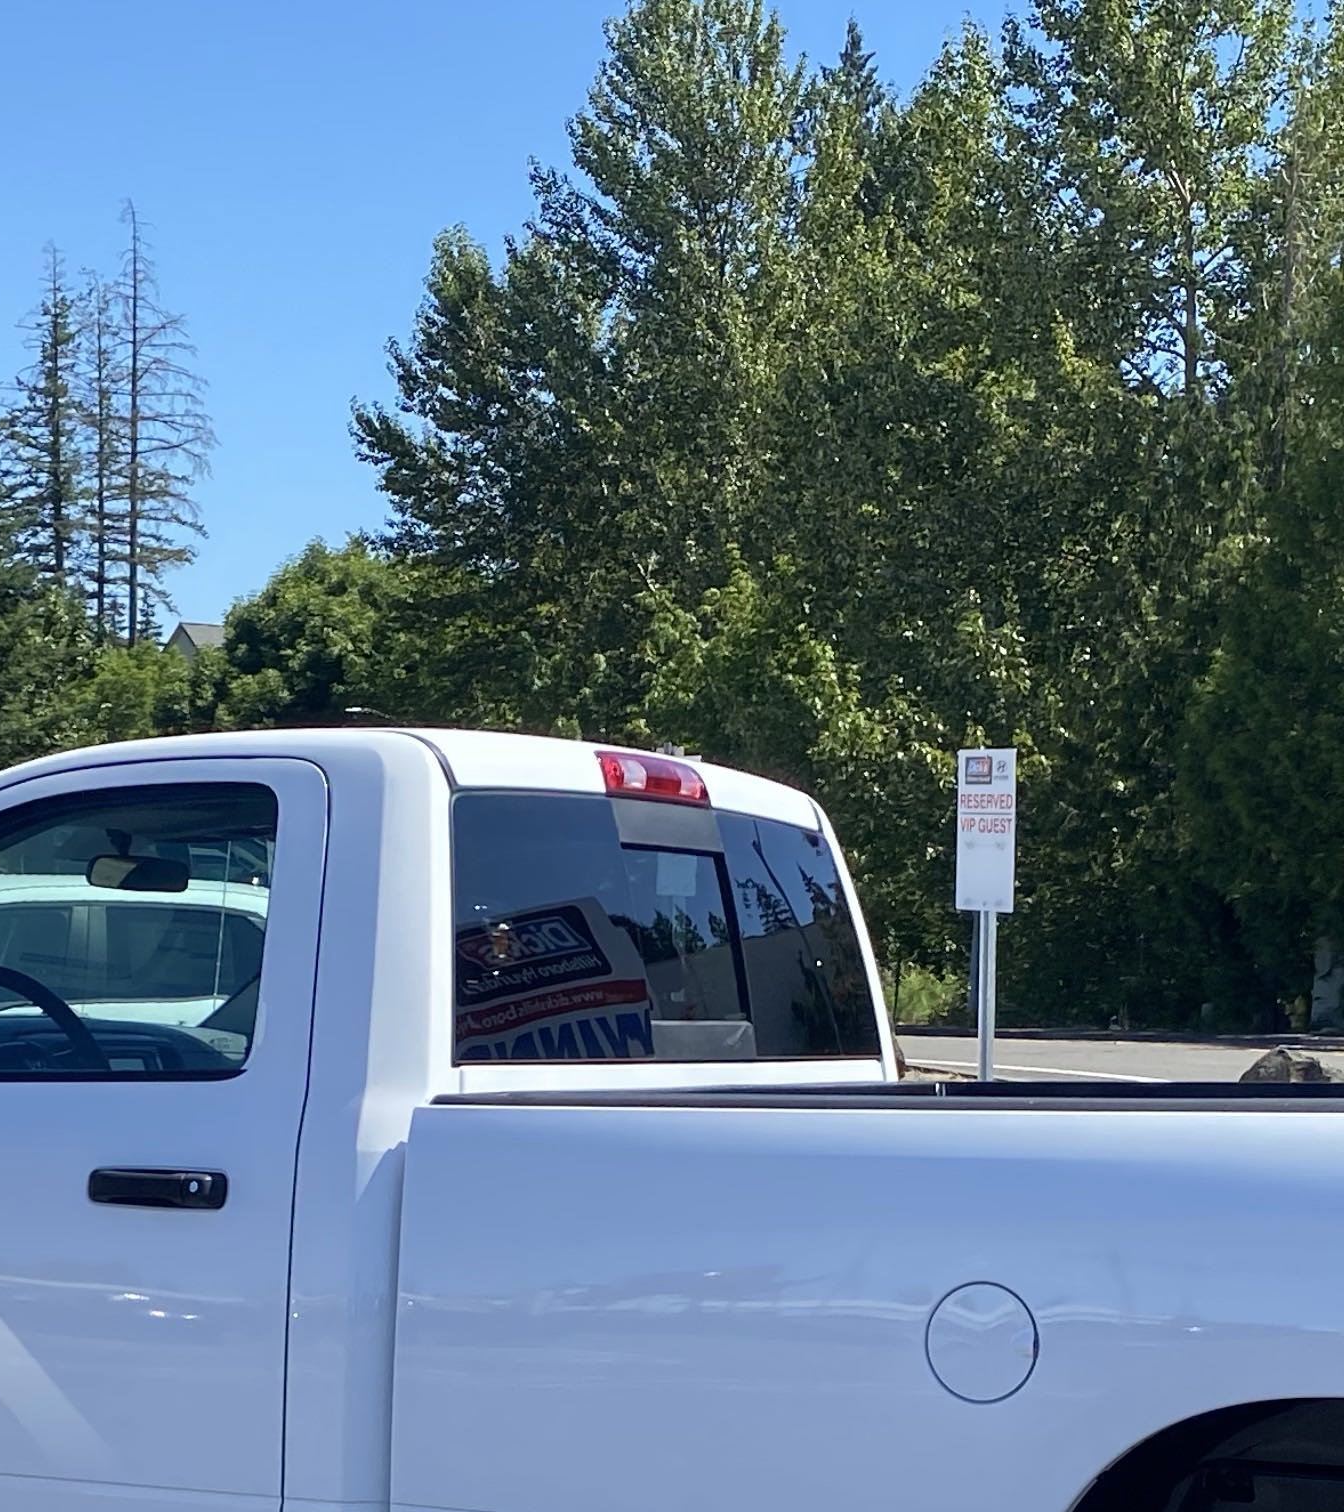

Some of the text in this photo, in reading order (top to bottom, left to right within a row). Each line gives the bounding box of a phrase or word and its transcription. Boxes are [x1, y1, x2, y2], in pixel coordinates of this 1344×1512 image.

[960, 793, 1013, 810] RESERVED
[960, 817, 1012, 834] VIP GUEST
